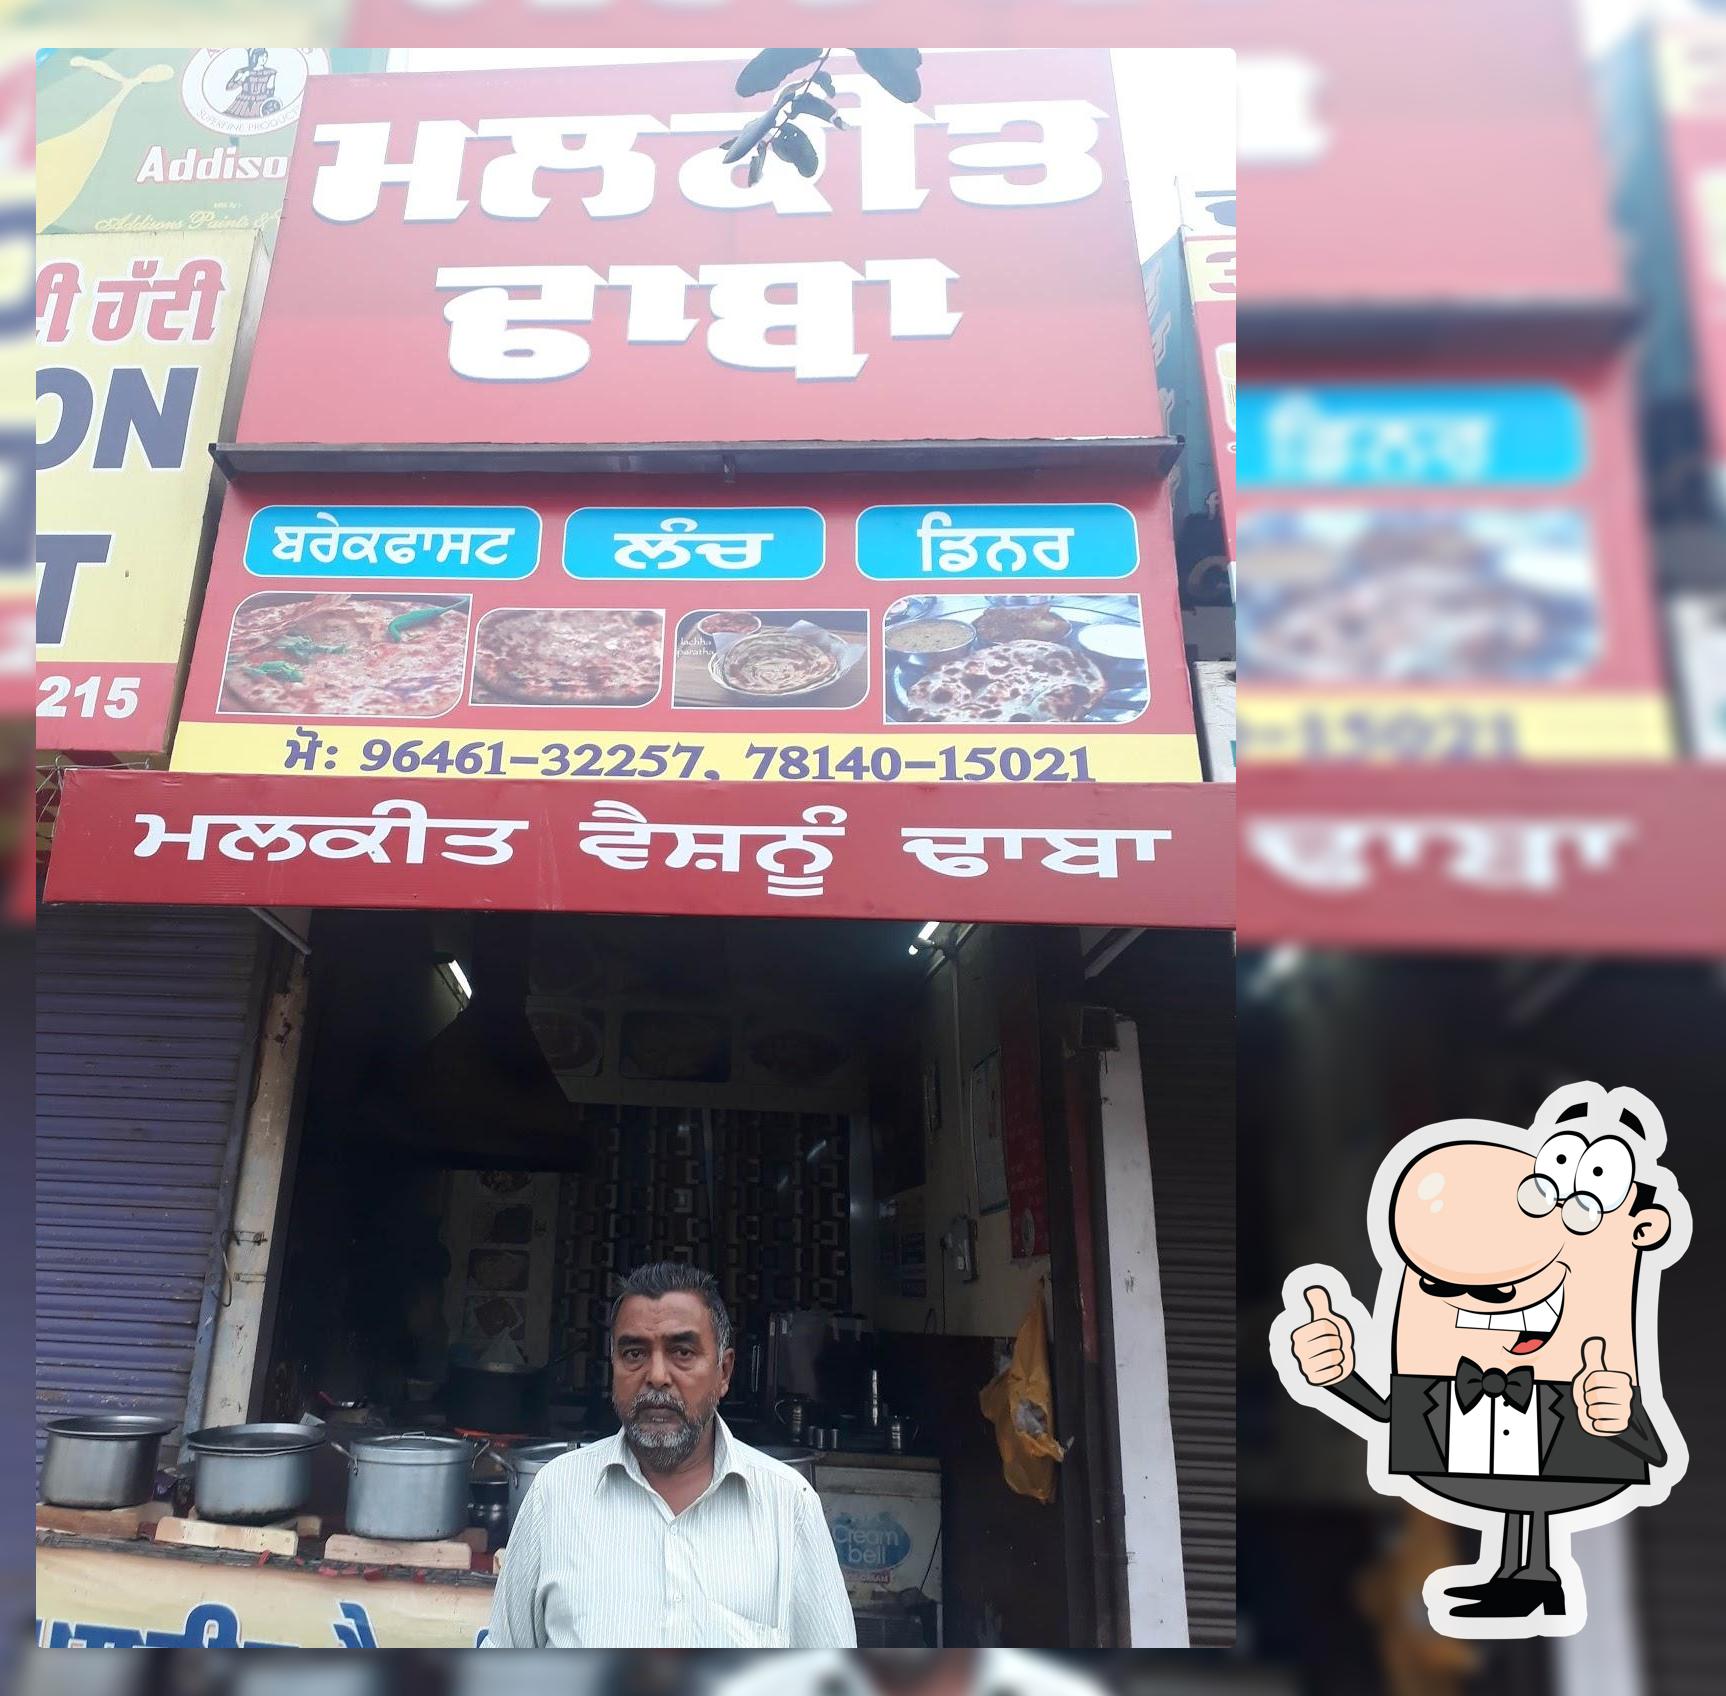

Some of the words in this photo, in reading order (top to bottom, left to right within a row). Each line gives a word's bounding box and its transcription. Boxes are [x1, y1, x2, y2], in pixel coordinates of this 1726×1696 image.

[136, 145, 289, 184] Addiso
[311, 73, 1111, 224] ਮਲਕੀਤ
[435, 258, 965, 380] ਢਾਬਾ
[272, 512, 515, 565] ਬਰੇਕਫਾਸਟ
[614, 517, 774, 570] ਲੰਚ
[917, 511, 1075, 573] ਡਿਨਰ
[36, 675, 141, 719] 215
[745, 743, 1096, 783] 78140-15021
[134, 799, 529, 866] ਮਲਕੀਤ
[901, 828, 1172, 879] ਢਾਬਾ
